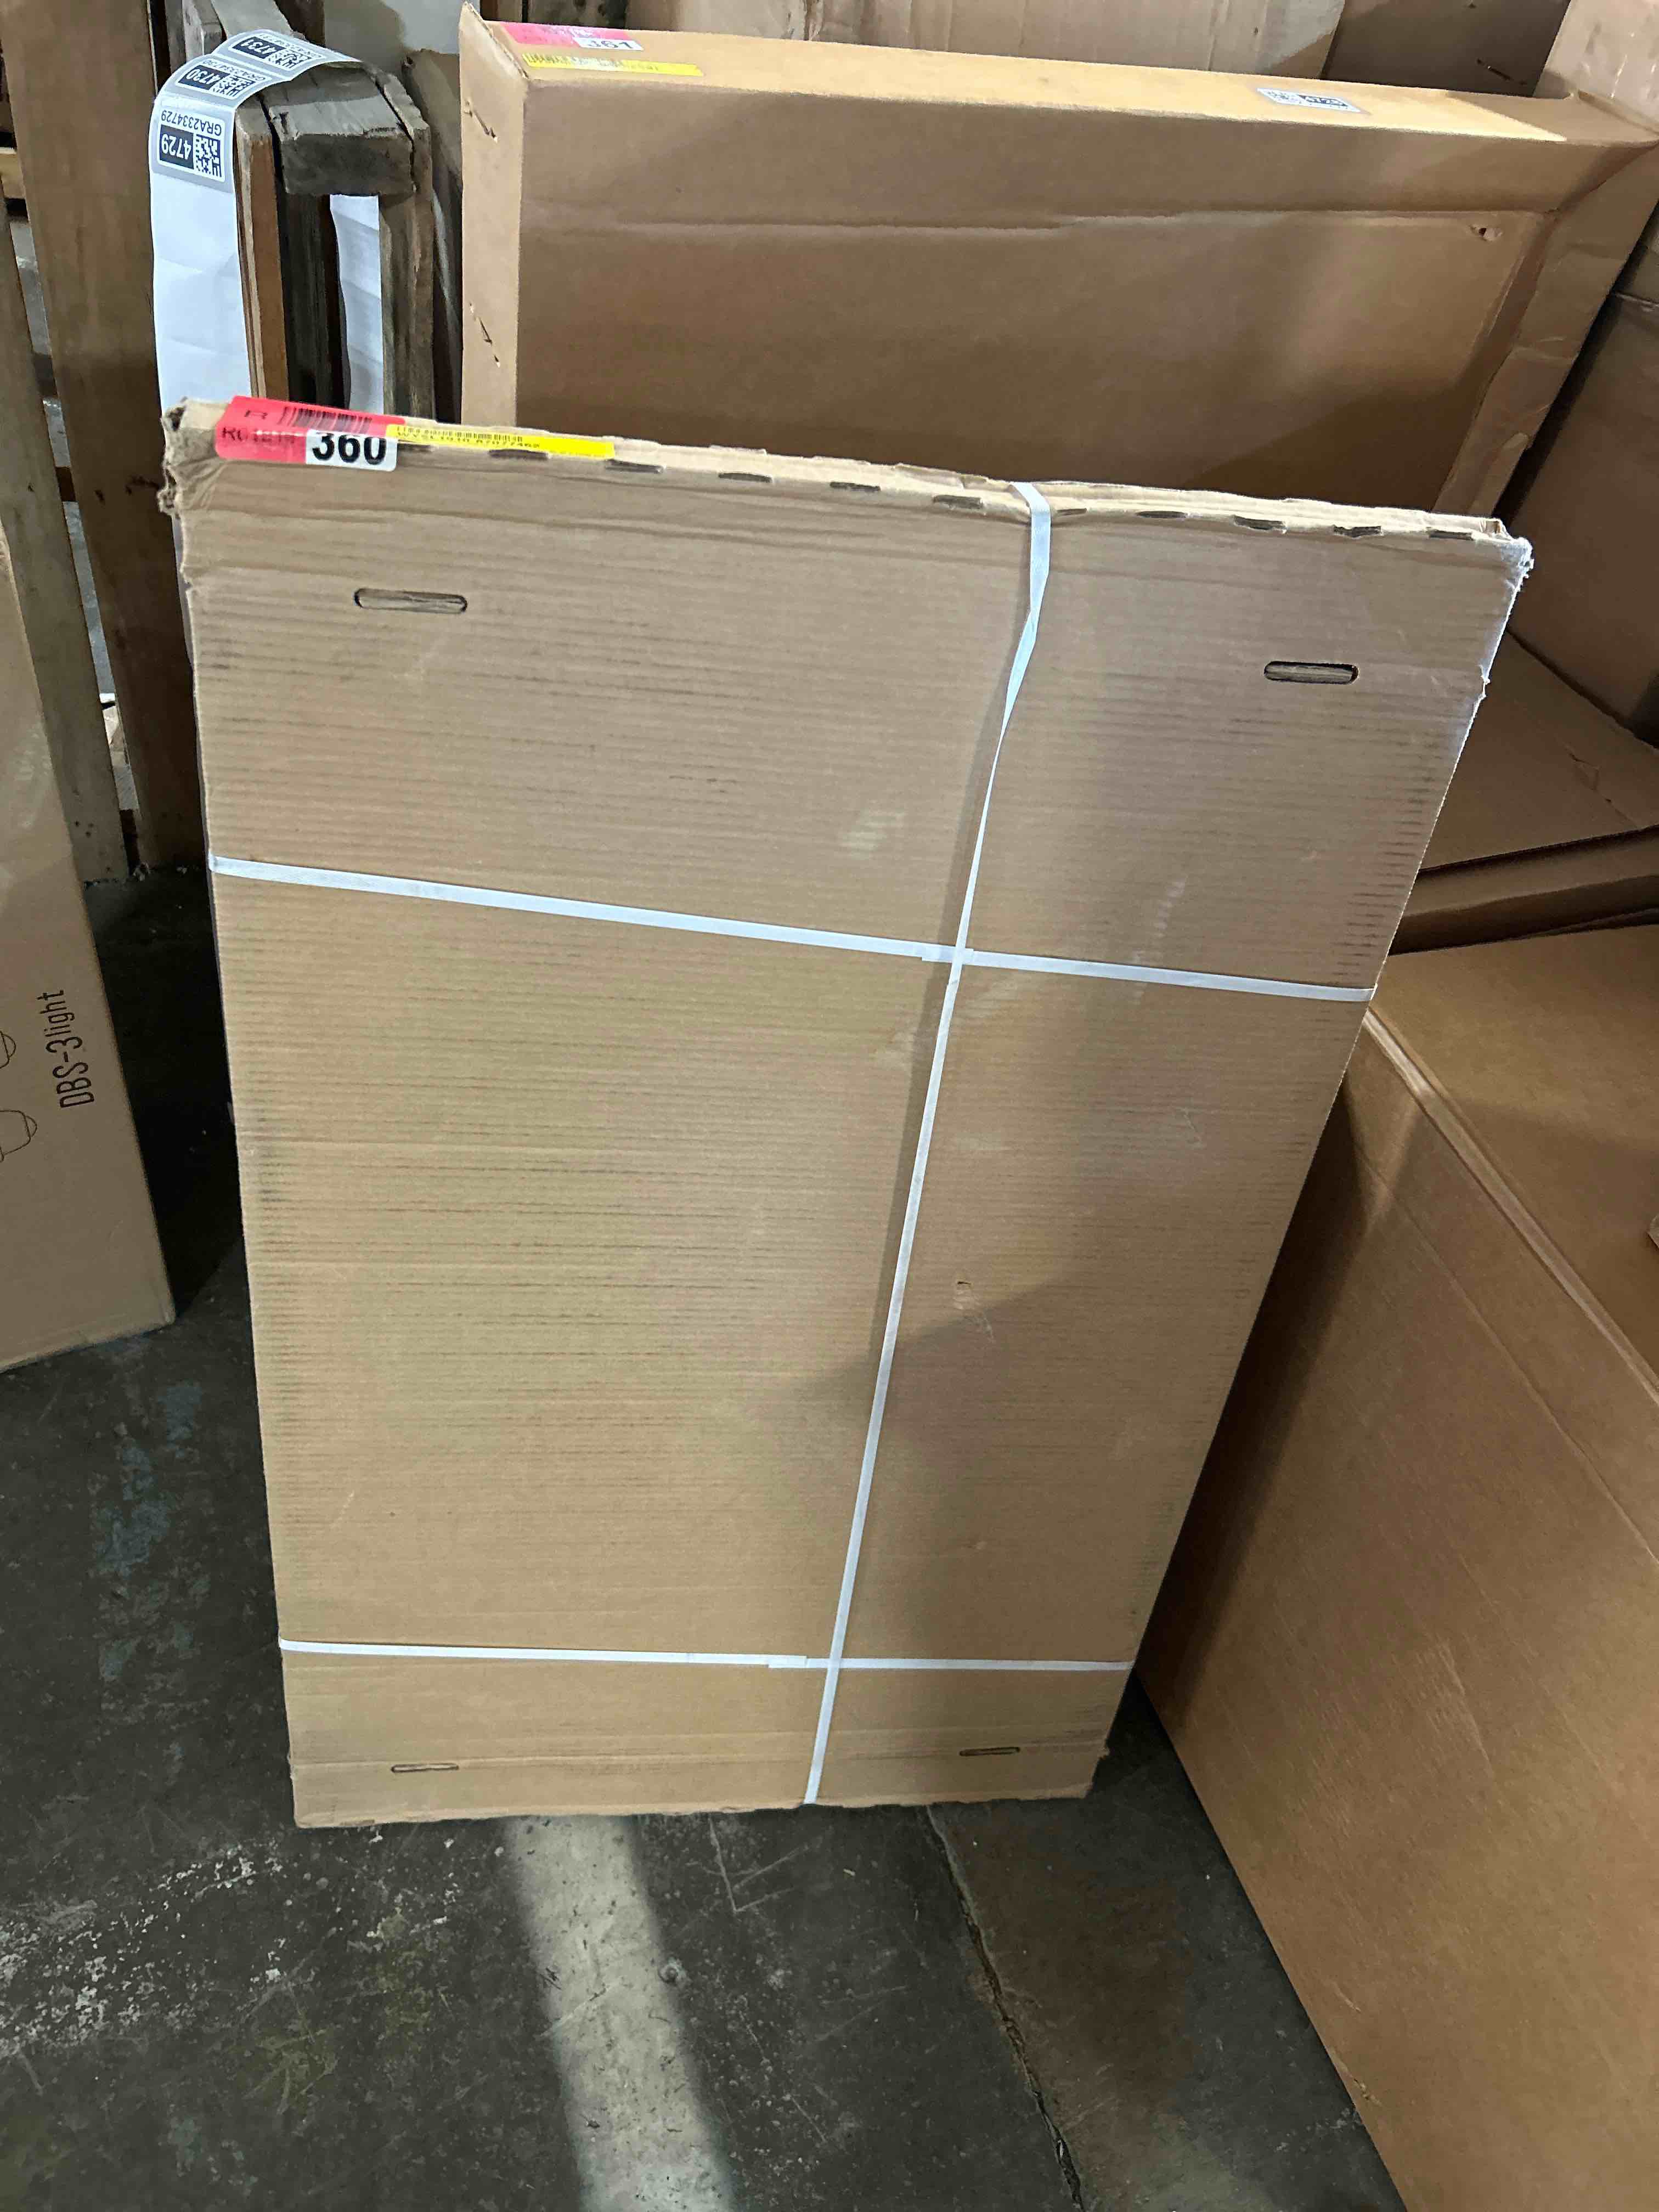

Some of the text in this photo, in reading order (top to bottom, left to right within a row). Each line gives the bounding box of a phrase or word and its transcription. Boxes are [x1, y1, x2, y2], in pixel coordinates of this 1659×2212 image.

[241, 39, 275, 54] 4731
[187, 69, 221, 84] 4730
[161, 110, 222, 136] GRA2334729
[161, 133, 191, 160] 4729
[312, 432, 386, 465] 360
